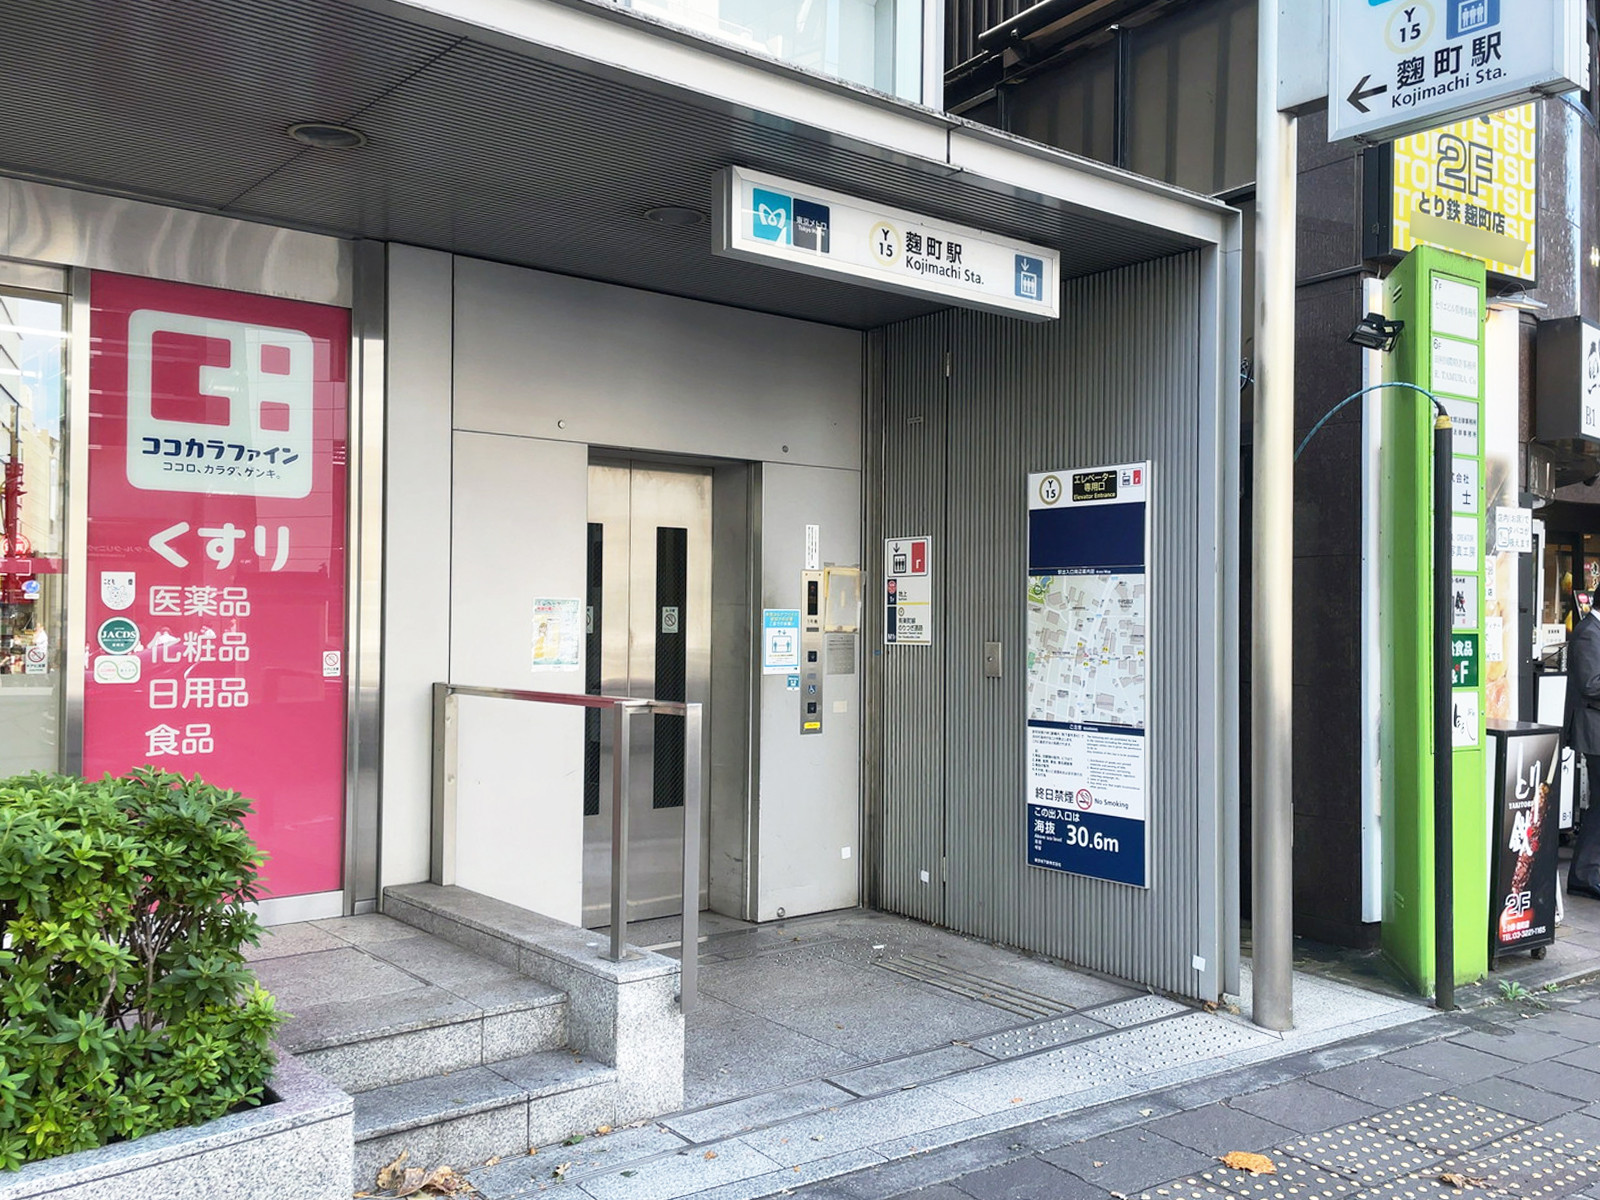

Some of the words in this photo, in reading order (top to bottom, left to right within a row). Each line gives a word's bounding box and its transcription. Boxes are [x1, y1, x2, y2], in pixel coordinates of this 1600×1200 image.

[1403, 7, 1416, 23] Y
[1400, 23, 1421, 43] 15
[1391, 72, 1470, 108] Kojimachi
[1475, 66, 1507, 85] Sta.
[1437, 133, 1493, 197] 2F
[881, 228, 890, 241] Y
[879, 242, 893, 257] 15
[905, 256, 961, 280] Kojimachi
[964, 269, 984, 285] Sta.
[142, 437, 299, 465] ココカラファイン
[1047, 480, 1054, 488] Y
[1073, 473, 1116, 484] エレベーター
[1083, 482, 1106, 493] 専用口
[1045, 489, 1056, 499] 15
[149, 522, 289, 571] くすり
[150, 586, 250, 616] 医薬品
[101, 630, 137, 639] JACDS
[149, 631, 249, 663] 化粧品
[150, 678, 249, 709] 日用品
[145, 724, 214, 757] 食品
[1035, 787, 1074, 804] 終日禁煙
[1094, 798, 1103, 806] No
[1104, 799, 1129, 810] Smoking
[1034, 807, 1080, 822] この出入口は
[1034, 819, 1056, 835] 海抜
[1066, 824, 1119, 853] 30.6m
[1504, 890, 1532, 920] 2F
